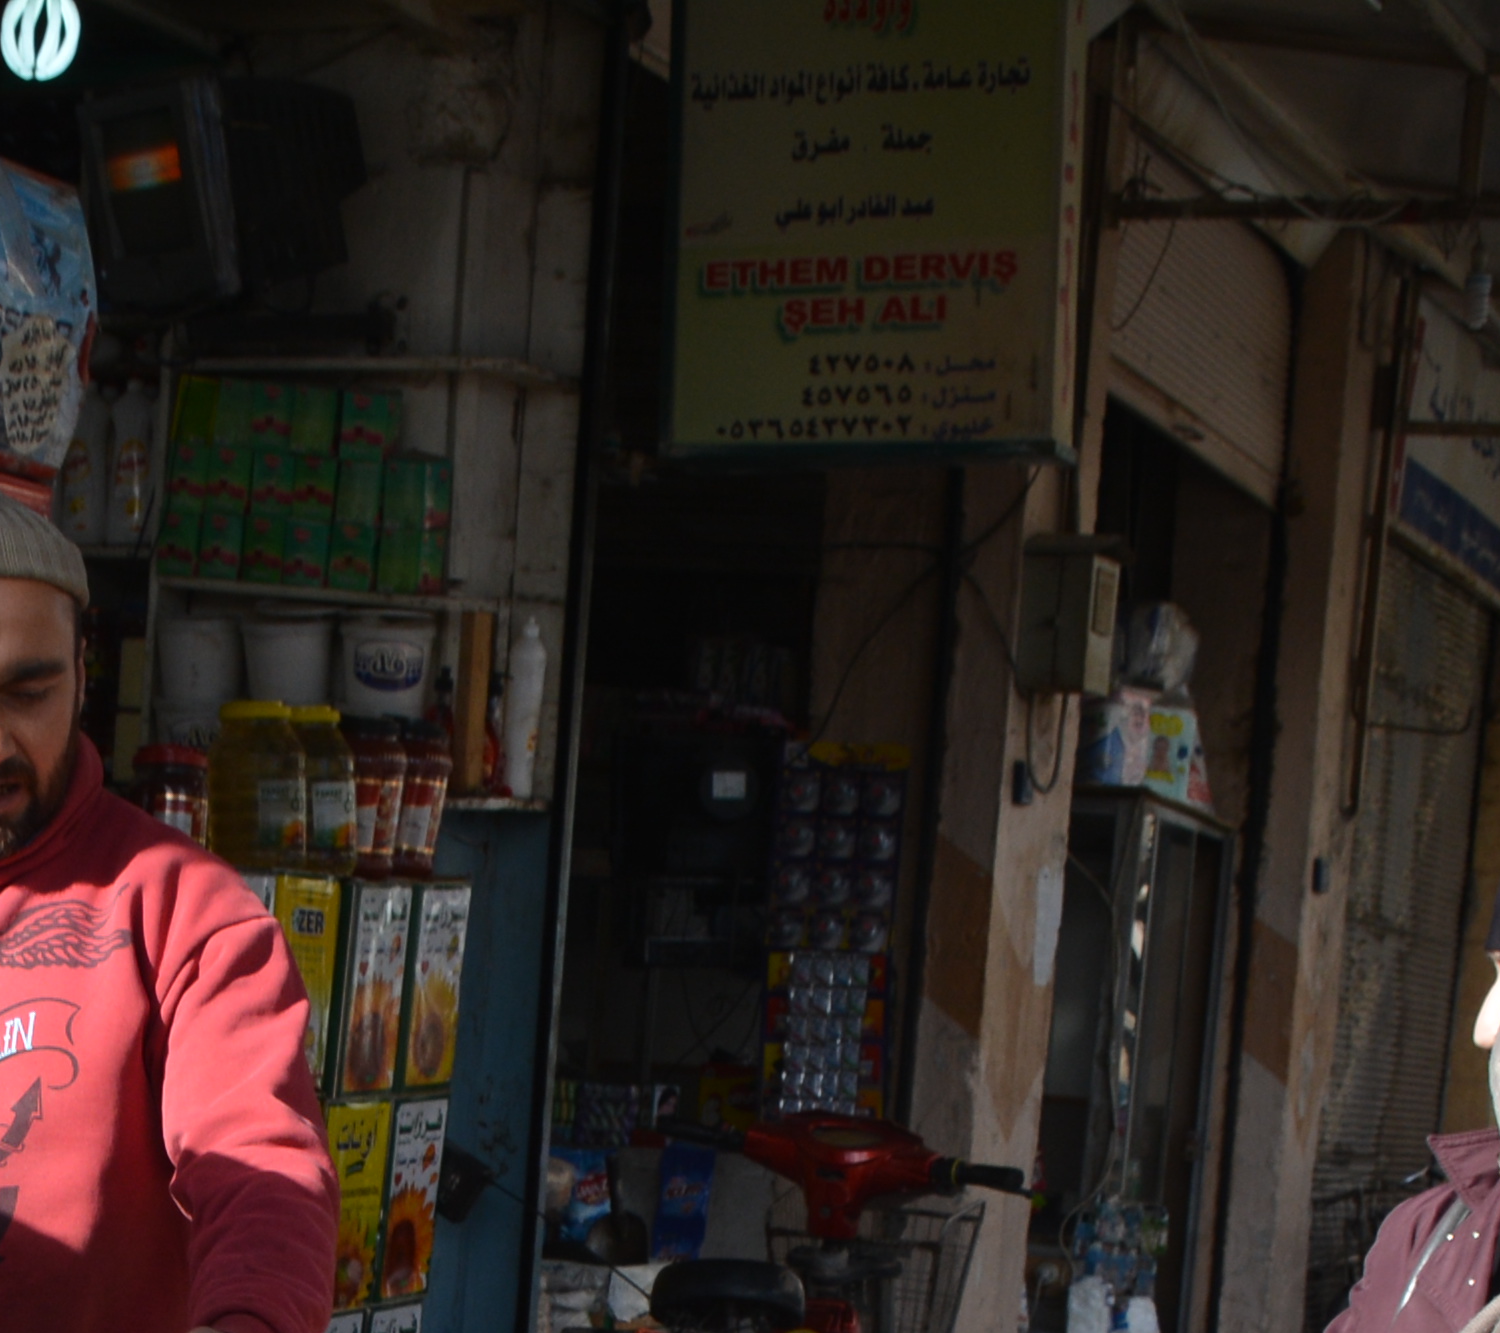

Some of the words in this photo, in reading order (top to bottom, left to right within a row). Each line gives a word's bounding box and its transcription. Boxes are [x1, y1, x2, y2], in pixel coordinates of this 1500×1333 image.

[880, 123, 933, 155] جملة
[704, 256, 848, 289] ETHEM
[862, 250, 1018, 284] DERVIŞ
[782, 297, 866, 332] ŞEH
[878, 293, 949, 324] ALI
